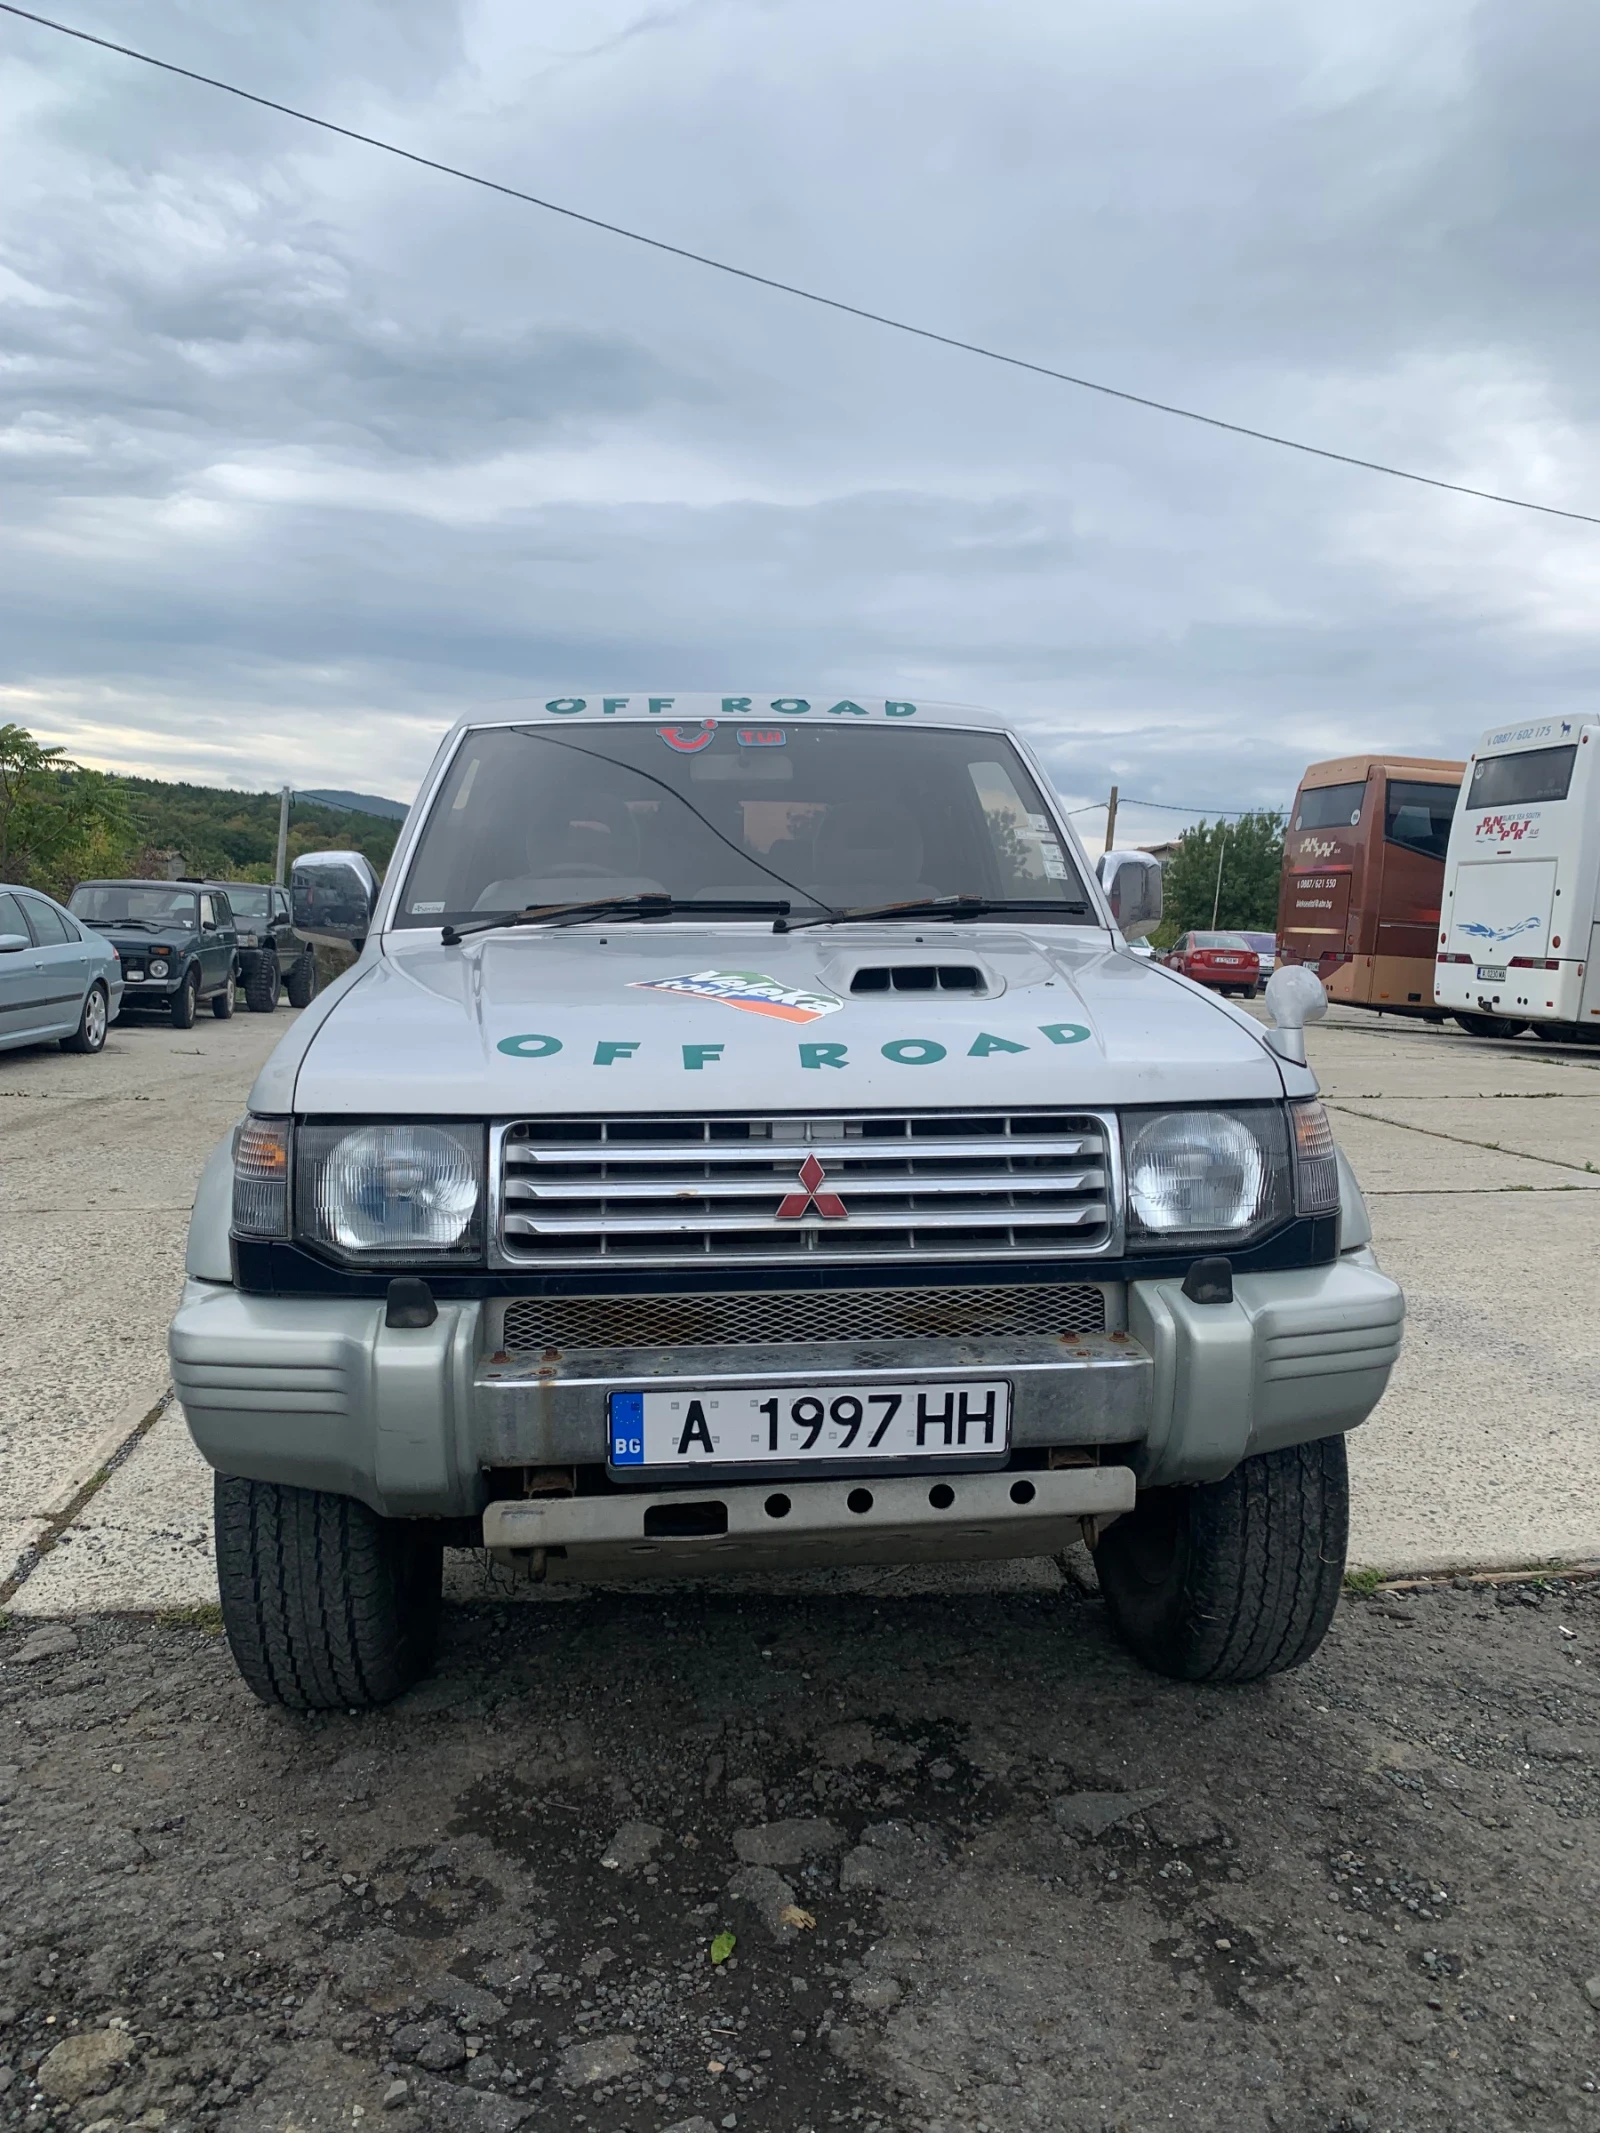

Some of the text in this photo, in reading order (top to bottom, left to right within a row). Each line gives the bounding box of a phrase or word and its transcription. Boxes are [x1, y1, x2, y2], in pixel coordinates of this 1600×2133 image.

[545, 697, 917, 717] OFF ROAD
[742, 731, 781, 744] TUI
[1535, 725, 1552, 738] 175
[1526, 811, 1541, 820] SOUTH
[654, 979, 745, 999] tour
[496, 1023, 1092, 1070] OFF ROAD
[677, 1400, 715, 1454] A
[615, 1437, 641, 1454] BG
